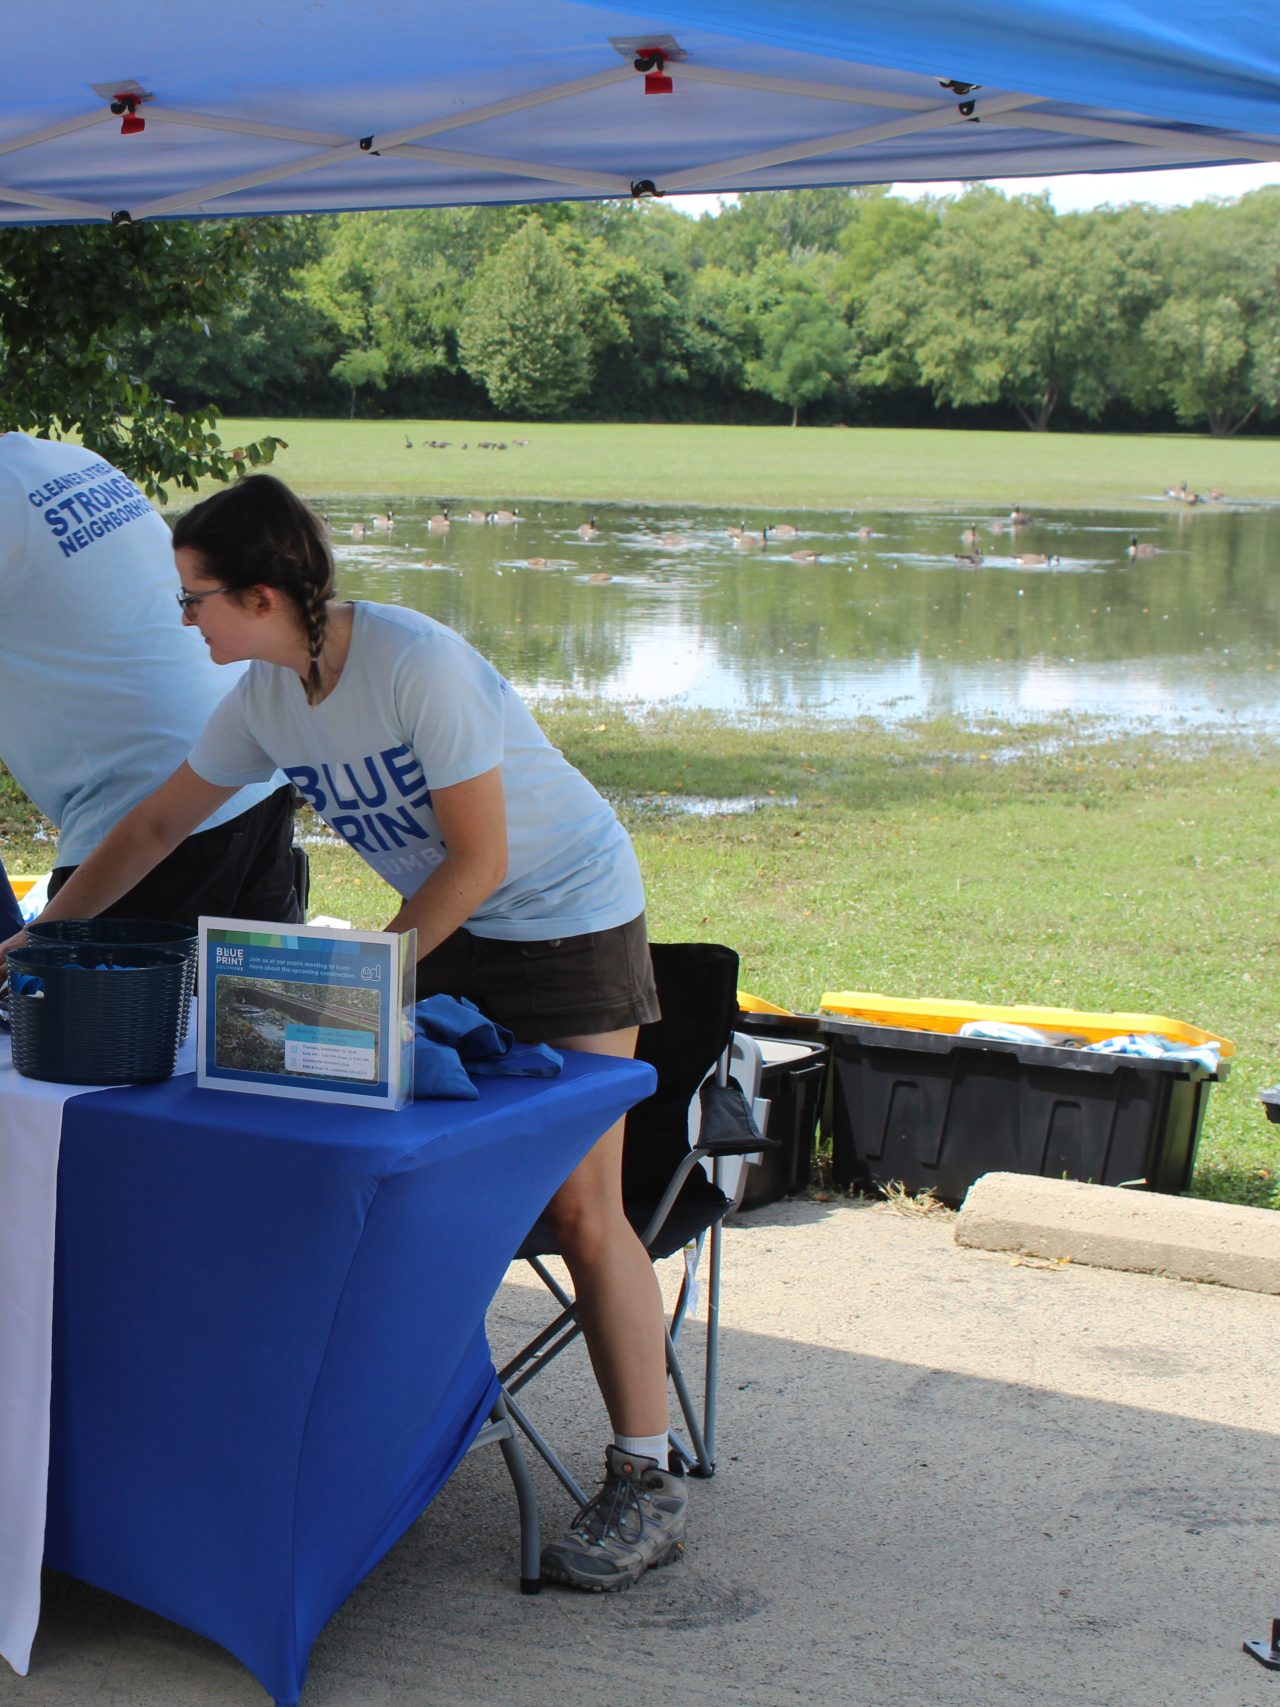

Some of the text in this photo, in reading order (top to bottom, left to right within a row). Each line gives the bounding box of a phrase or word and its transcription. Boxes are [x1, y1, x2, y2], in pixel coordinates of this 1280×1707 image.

[28, 472, 87, 508] CLEANER
[282, 743, 427, 812] BLUE
[216, 947, 244, 957] BLUE
[216, 956, 244, 966] PRINT
